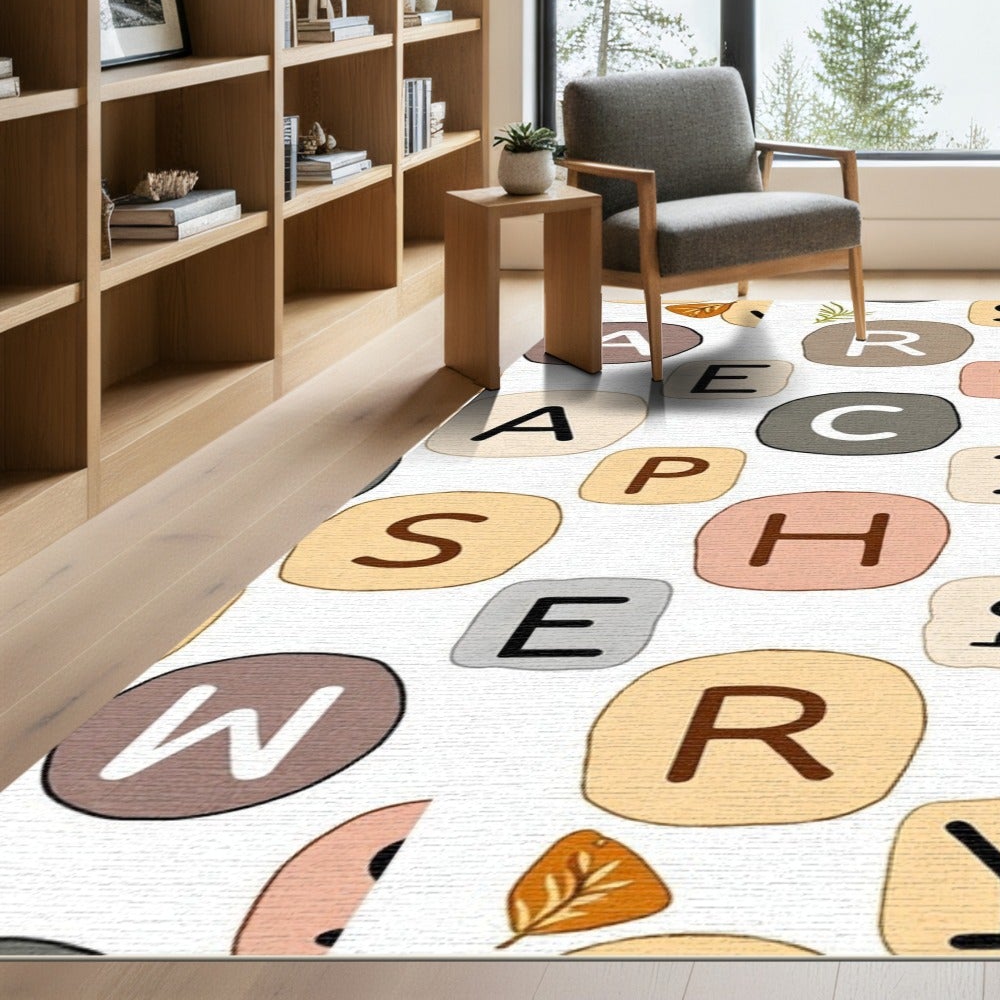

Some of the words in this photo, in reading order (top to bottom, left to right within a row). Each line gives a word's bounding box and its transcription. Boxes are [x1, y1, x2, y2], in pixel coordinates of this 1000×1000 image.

[602, 330, 651, 357] A
[846, 330, 926, 356] R
[690, 364, 771, 393] E
[470, 406, 574, 442] A
[811, 405, 903, 441] C
[625, 456, 709, 494] P
[351, 513, 489, 568] S
[749, 513, 890, 567] H
[497, 596, 630, 658] E
[99, 685, 344, 781] W
[667, 685, 833, 783] R
